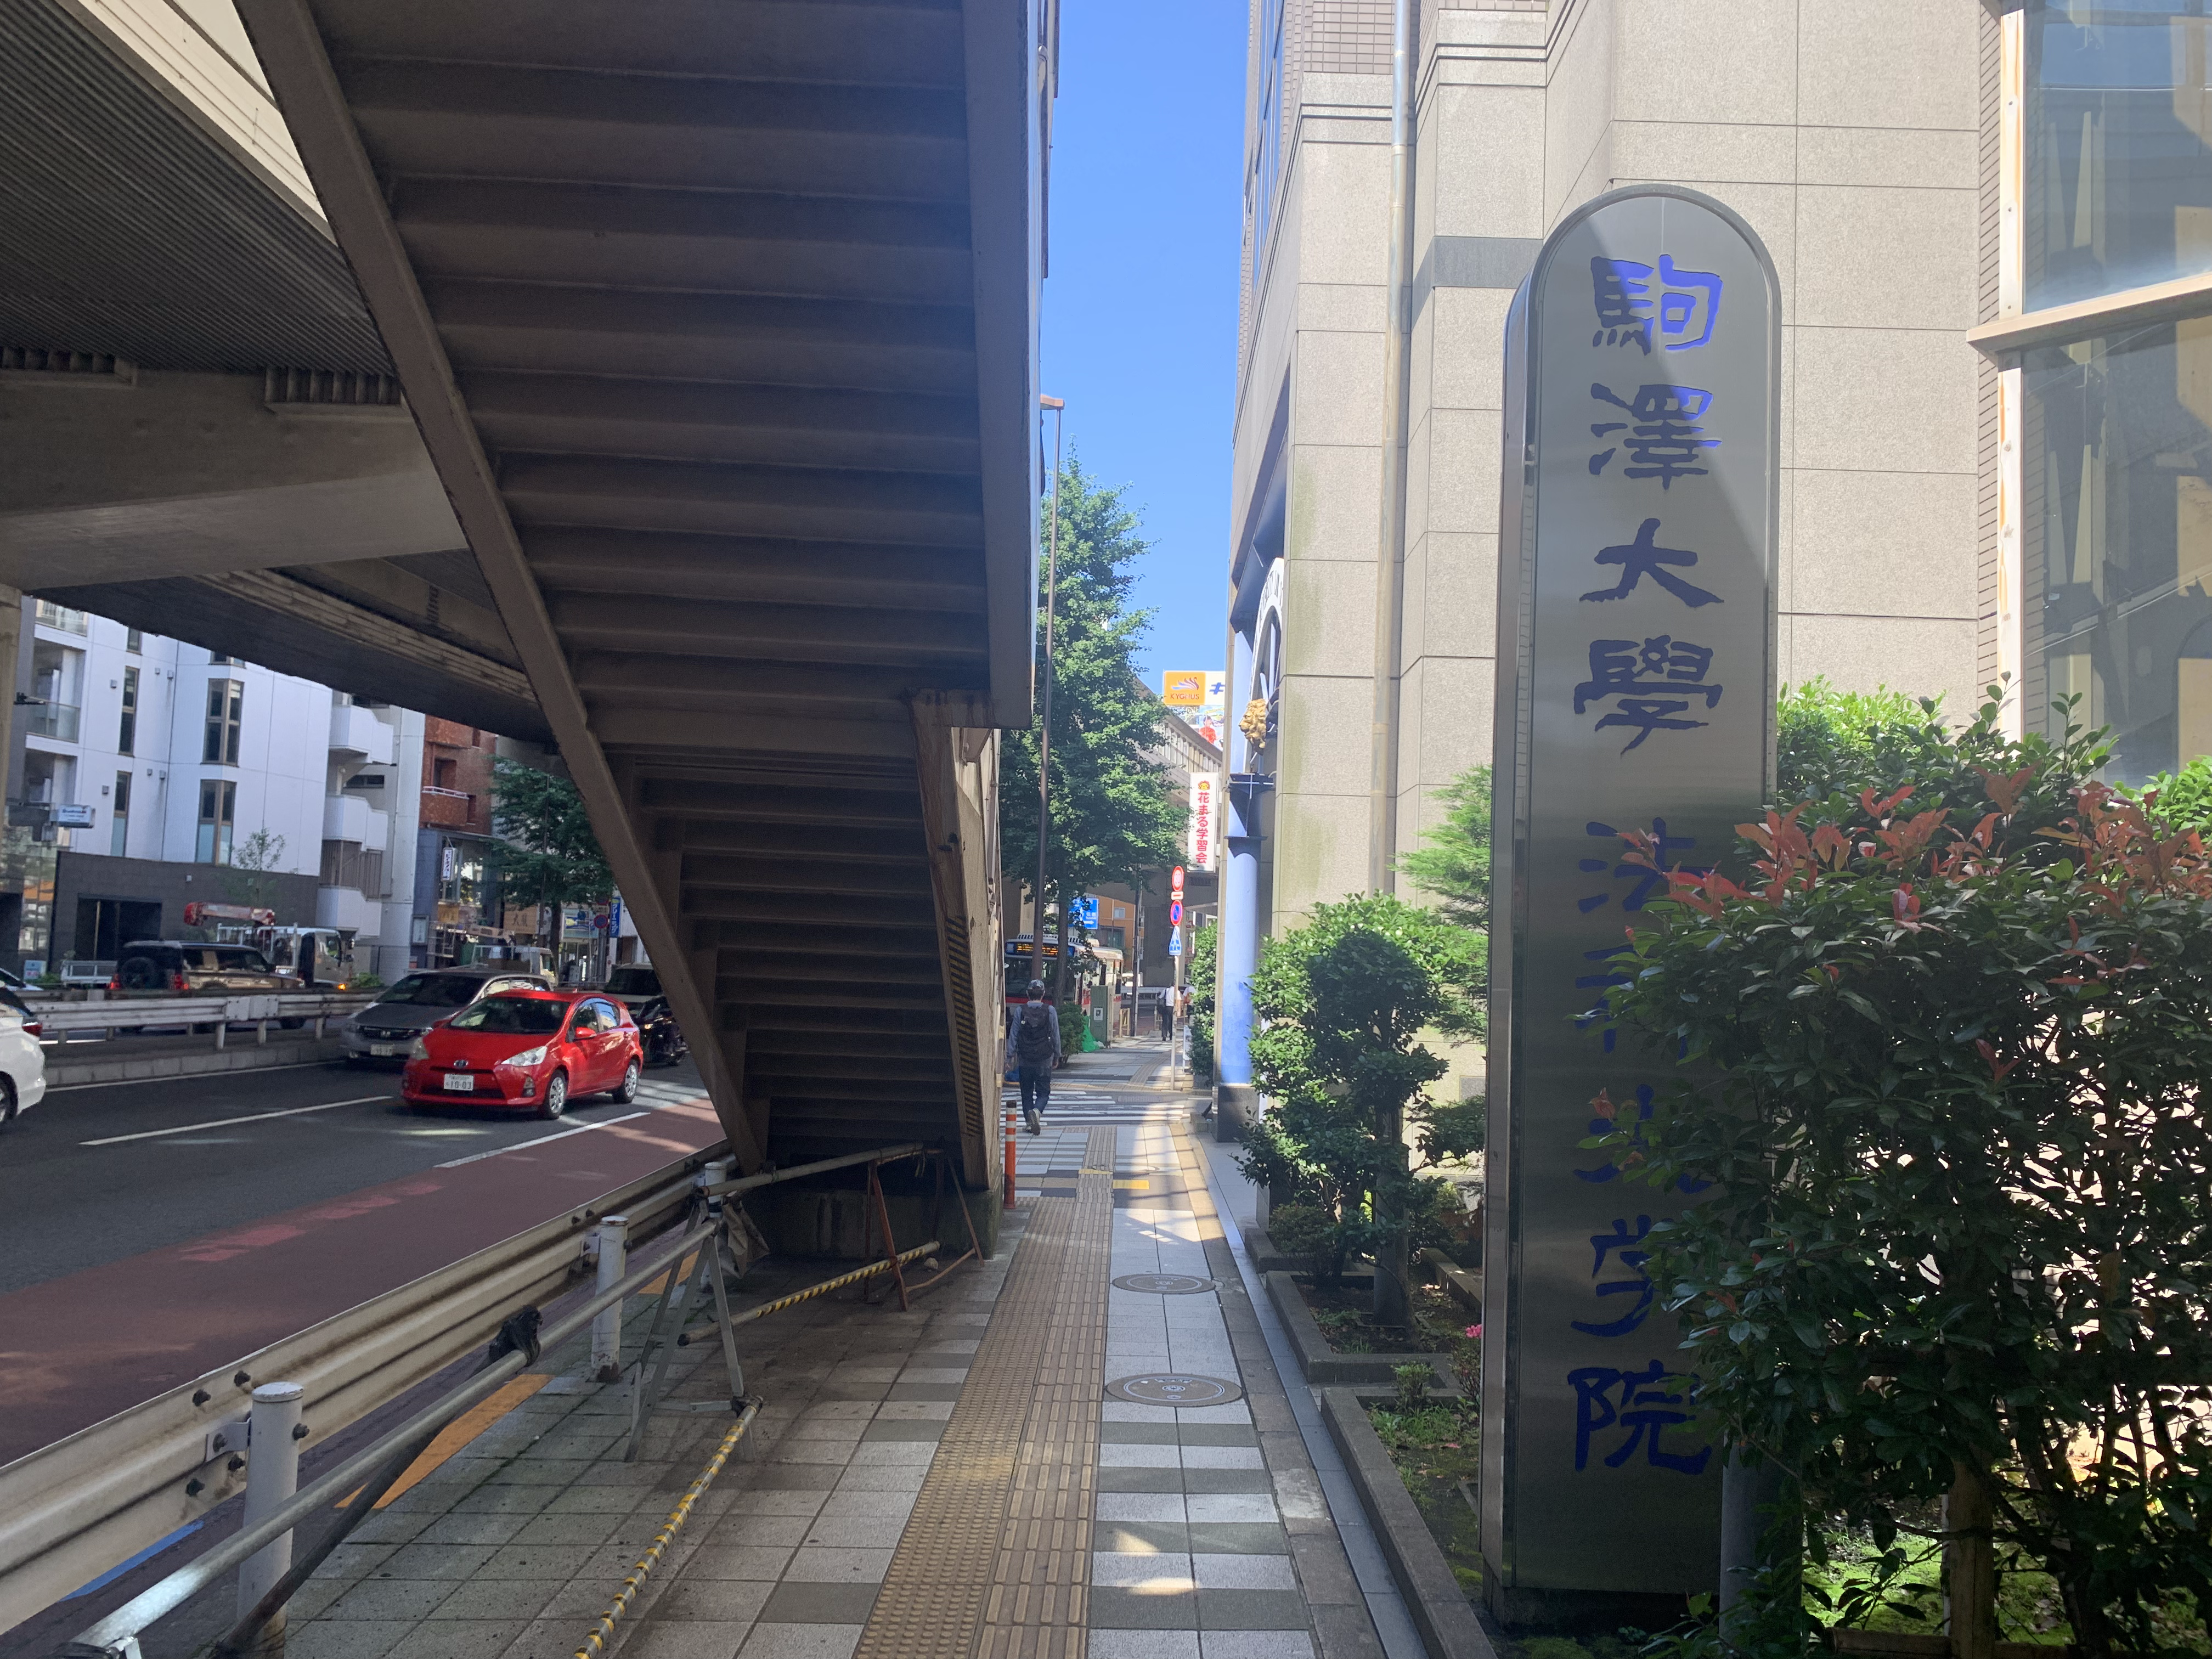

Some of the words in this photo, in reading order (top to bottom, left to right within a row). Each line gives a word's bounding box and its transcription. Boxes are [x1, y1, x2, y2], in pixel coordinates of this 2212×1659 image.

[1573, 253, 1724, 755] 駒澤大學
[1195, 792, 1210, 864] 花まる学習会
